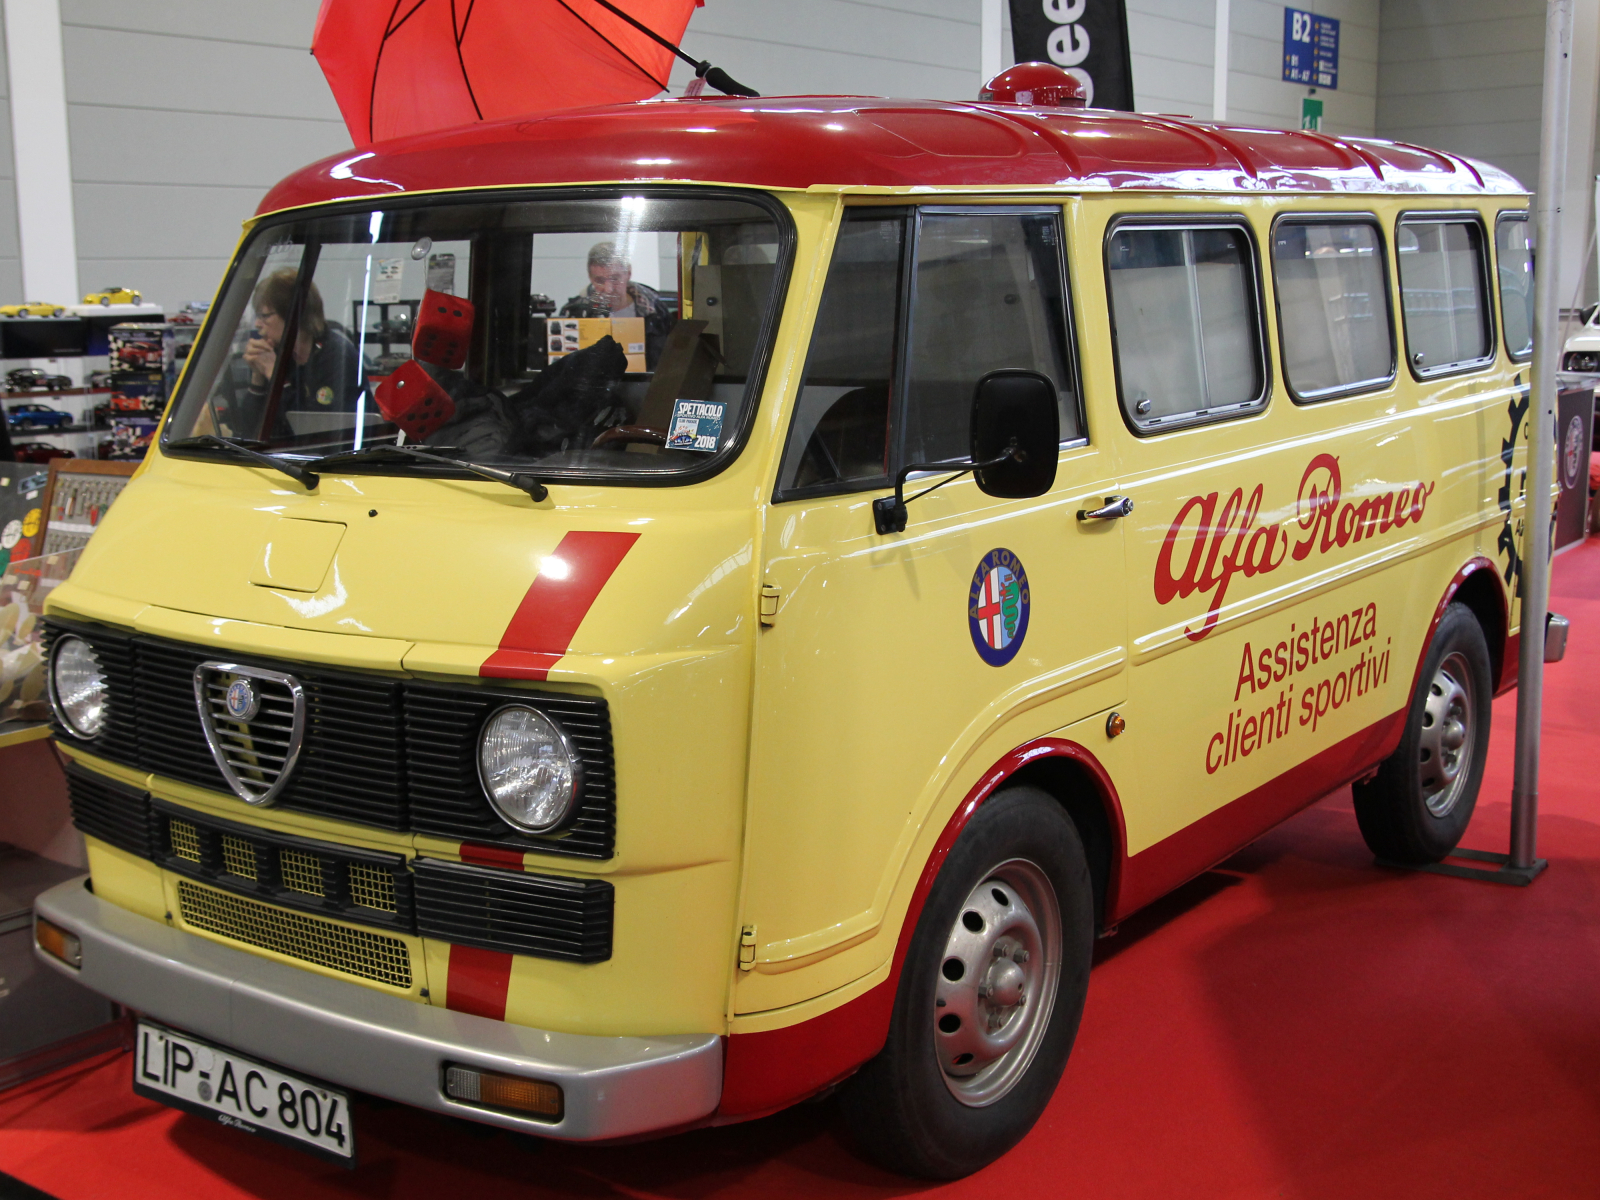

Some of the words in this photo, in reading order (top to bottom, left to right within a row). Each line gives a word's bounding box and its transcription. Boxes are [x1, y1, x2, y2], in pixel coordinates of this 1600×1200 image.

[1042, 0, 1094, 108] ee
[1292, 11, 1311, 43] B2
[677, 403, 723, 417] SPETTACOLO
[694, 435, 716, 448] 2018
[1153, 483, 1287, 641] Alfa
[1292, 453, 1435, 562] Romeo
[969, 560, 991, 620] ALFA
[991, 550, 1030, 605] ROMEO
[1233, 602, 1377, 702] Assistenza
[1205, 684, 1294, 775] clienti
[1298, 637, 1392, 733] sportivi
[278, 1081, 346, 1149] 804
